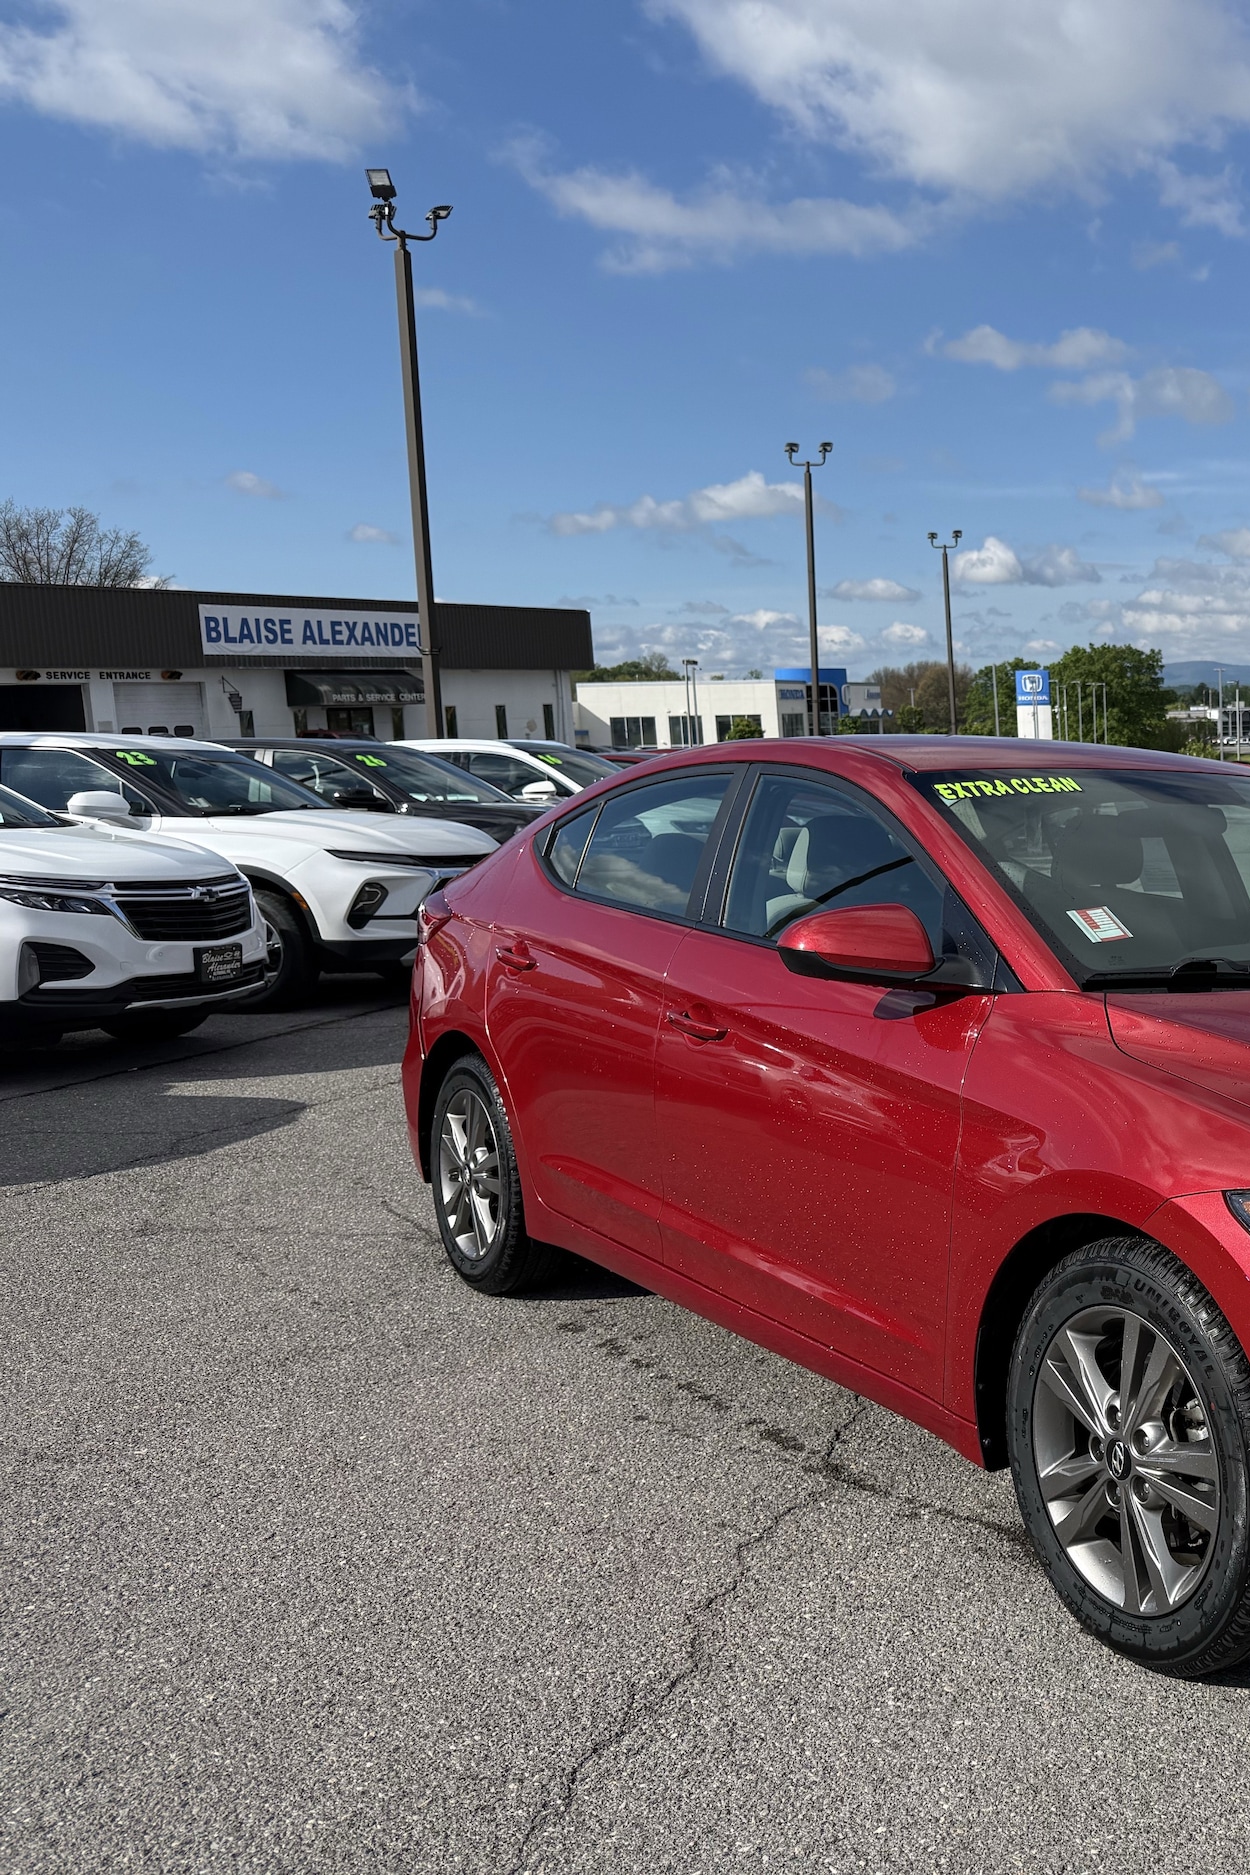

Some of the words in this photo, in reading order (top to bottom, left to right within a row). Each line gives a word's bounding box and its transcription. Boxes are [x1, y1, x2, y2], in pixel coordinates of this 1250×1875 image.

[204, 616, 294, 645] BLAISE
[302, 620, 421, 647] ALEXANDE
[45, 671, 91, 680] SERVICE
[99, 671, 152, 680] ENTRANCE
[332, 693, 356, 702] PARTS
[358, 693, 364, 702] &
[366, 693, 396, 702] SERVICE
[115, 751, 157, 766] 23
[933, 779, 1015, 800] EXTRA
[1010, 776, 1083, 794] CLEAN
